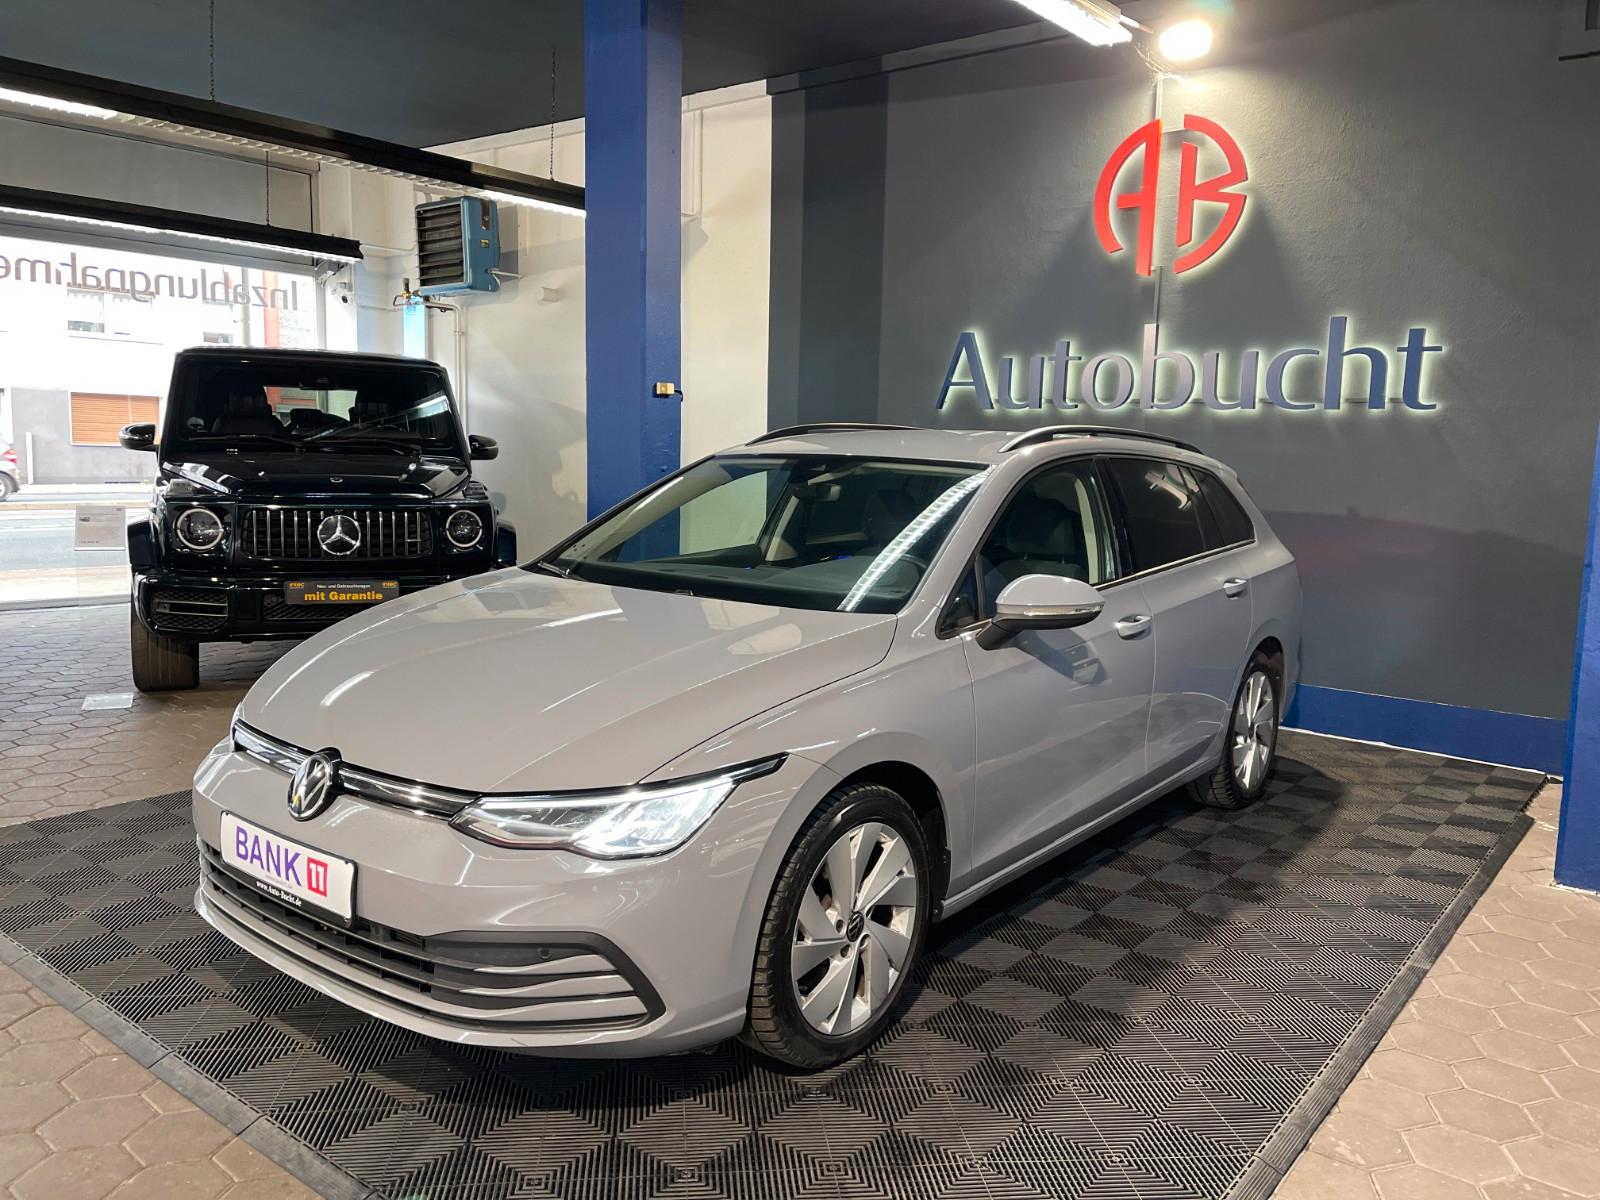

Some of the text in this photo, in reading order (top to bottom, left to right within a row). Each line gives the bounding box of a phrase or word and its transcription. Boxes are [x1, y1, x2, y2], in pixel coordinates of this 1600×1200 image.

[1094, 114, 1249, 276] AB
[935, 316, 1444, 410] Autobucht
[304, 591, 384, 601] mit Garantie
[236, 825, 326, 895] BANK 11
